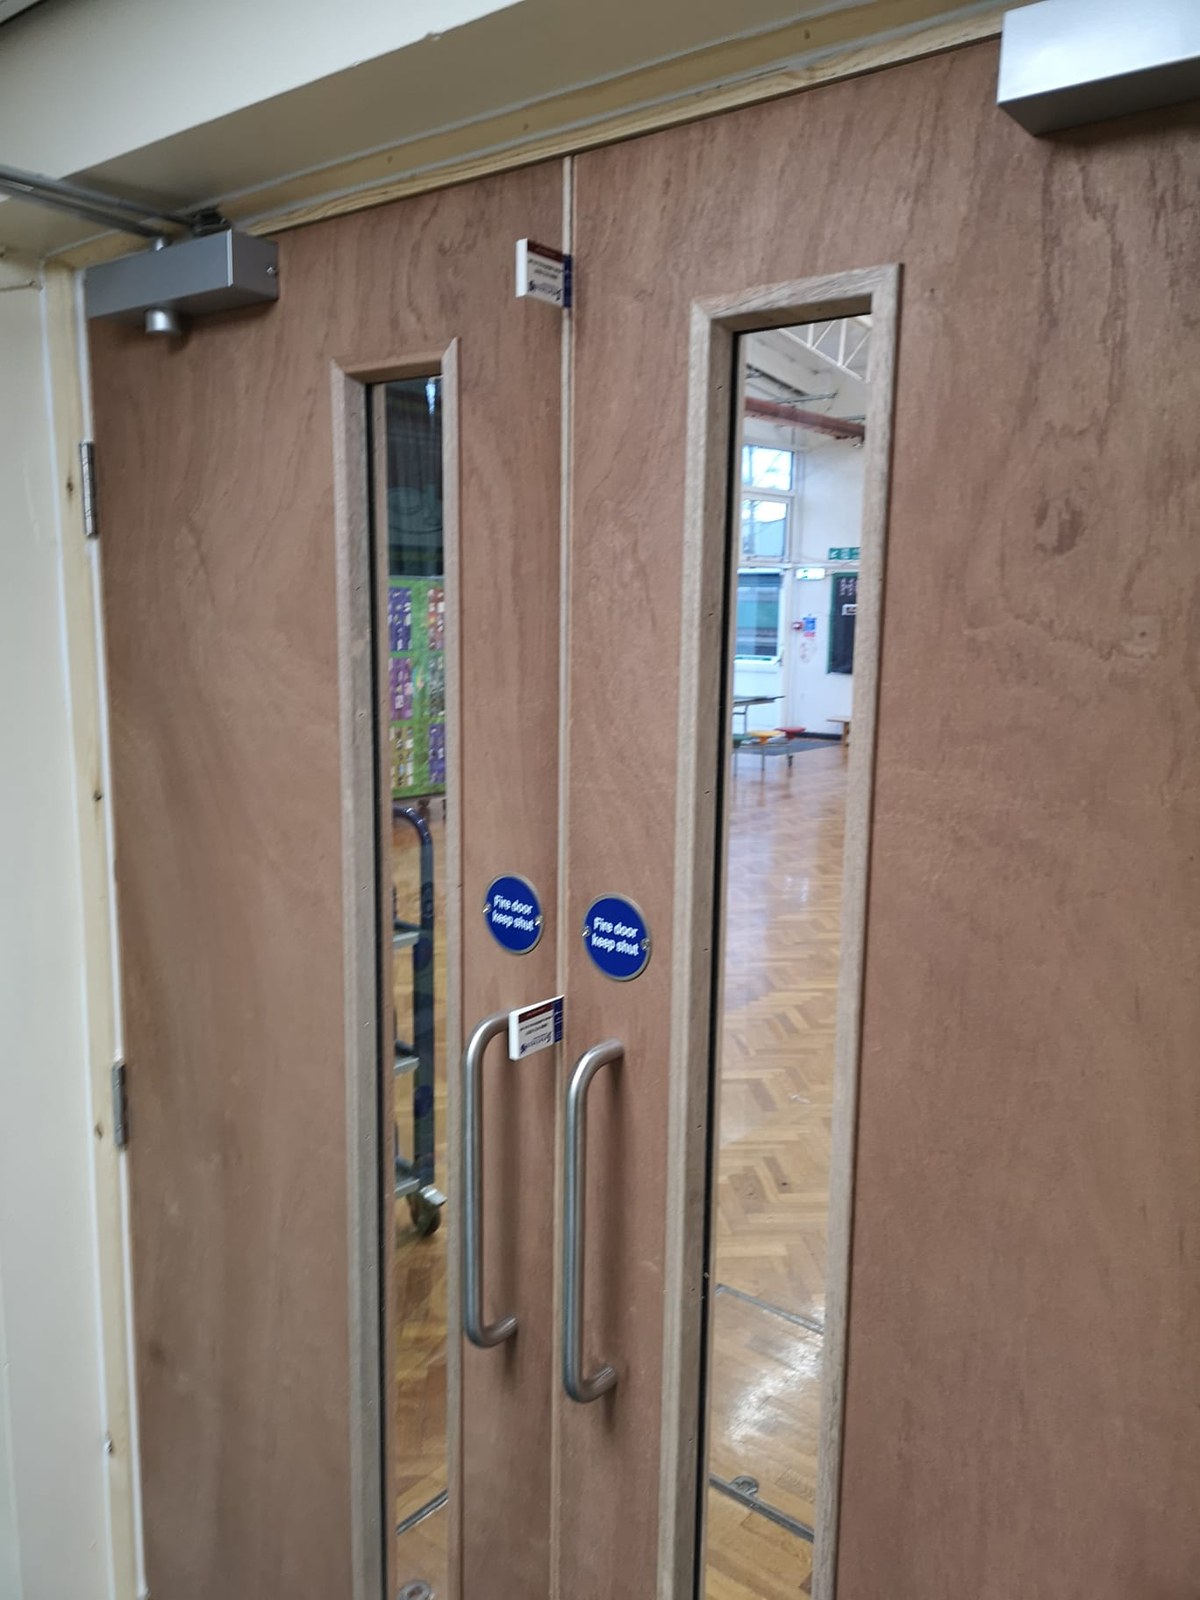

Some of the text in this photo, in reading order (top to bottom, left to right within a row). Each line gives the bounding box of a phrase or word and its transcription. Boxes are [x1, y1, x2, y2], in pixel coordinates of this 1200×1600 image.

[493, 894, 534, 915] Fire door
[492, 910, 535, 932] keep shut
[593, 916, 639, 939] Fire door
[591, 933, 639, 957] keep shut
